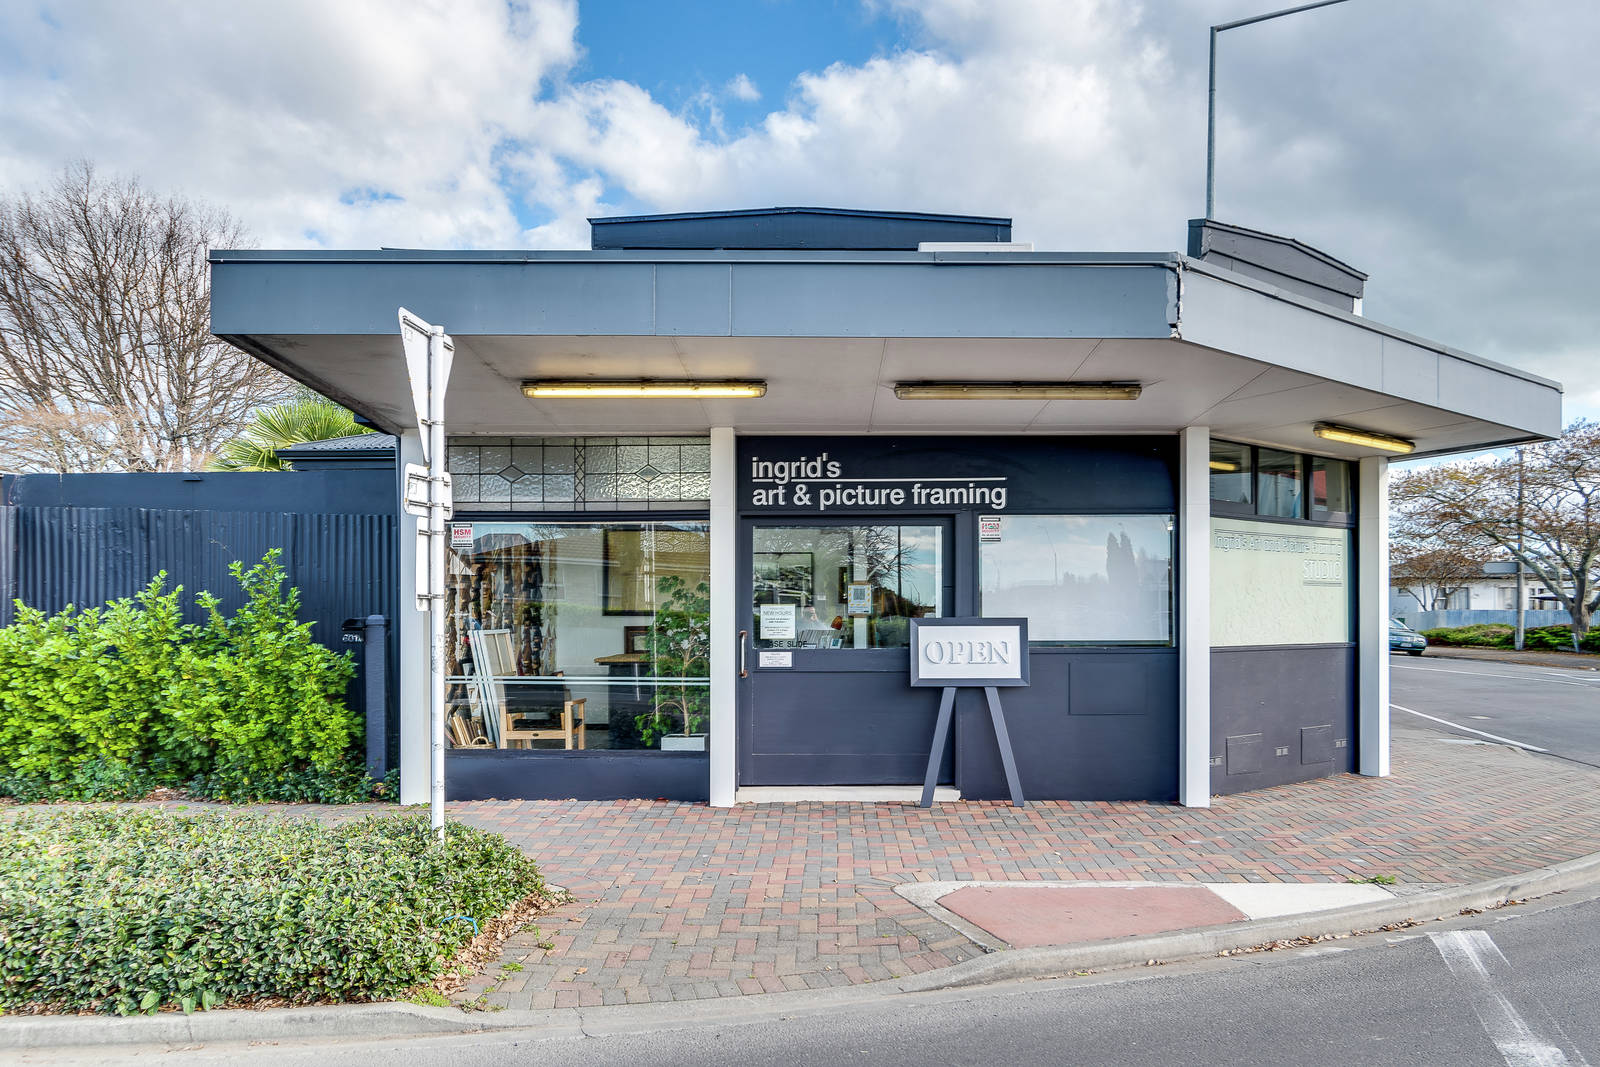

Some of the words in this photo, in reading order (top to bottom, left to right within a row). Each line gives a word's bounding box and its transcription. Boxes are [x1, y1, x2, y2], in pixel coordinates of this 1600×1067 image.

[752, 453, 841, 484] ingrid's
[752, 485, 786, 506] art
[793, 484, 812, 506] &
[819, 484, 905, 511] picture
[911, 483, 1008, 510] framing
[453, 528, 472, 536] HSM
[1303, 558, 1342, 580] STUDIO
[787, 640, 808, 648] SLIDE
[925, 641, 1011, 665] OPEN
